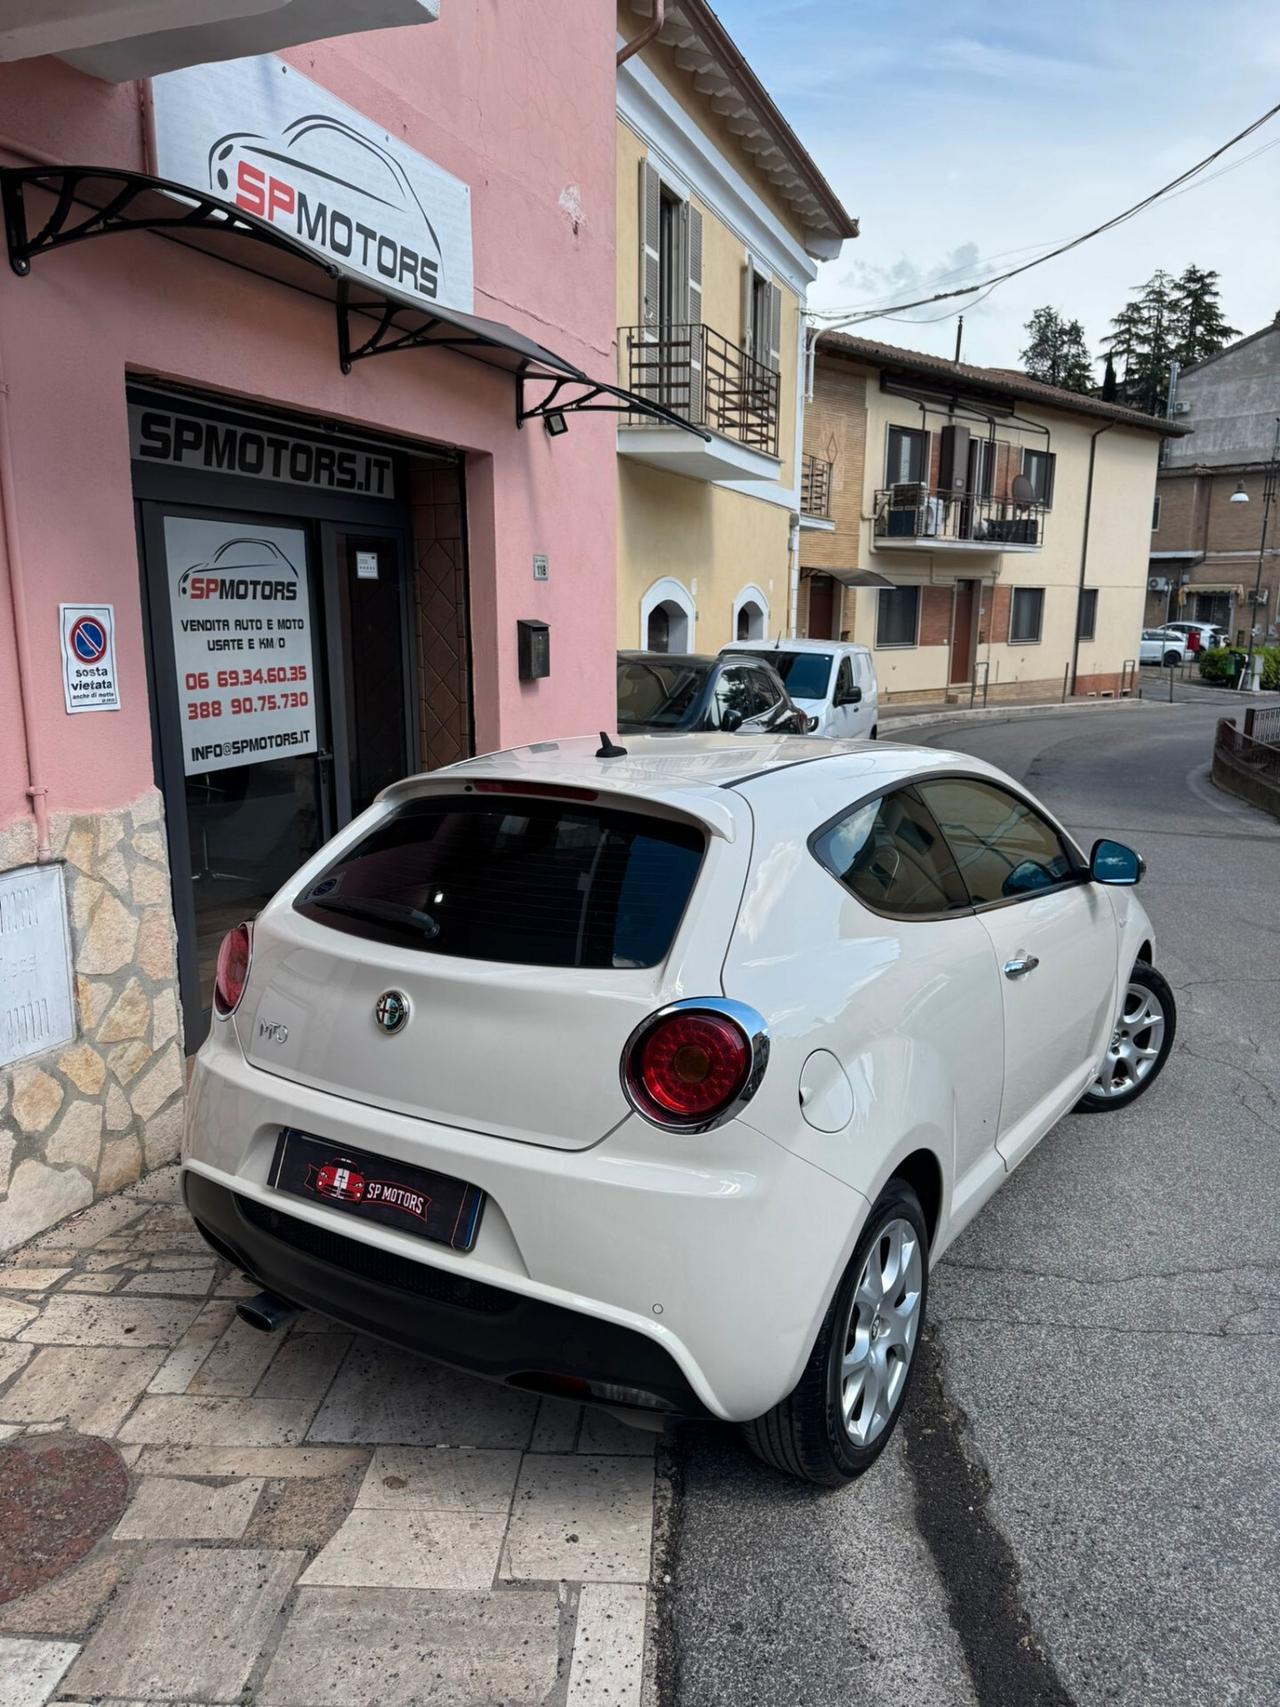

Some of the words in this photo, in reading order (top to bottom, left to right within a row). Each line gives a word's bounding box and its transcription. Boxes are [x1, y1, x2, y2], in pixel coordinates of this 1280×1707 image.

[236, 160, 438, 299] SPMOTORS
[140, 411, 390, 494] SPMOTORS.IT
[190, 577, 297, 601] SPMOTORS
[181, 619, 230, 632] VENDITA
[234, 619, 263, 631] AUTO
[267, 619, 274, 630] E
[277, 618, 304, 630] MOTO
[207, 638, 243, 652] USATE
[248, 639, 255, 650] E
[75, 667, 108, 677] sosta
[185, 672, 210, 690] 06
[217, 665, 307, 688] 69.34.60.35
[71, 680, 112, 691] vietata
[187, 700, 222, 720] 388
[231, 691, 309, 715] 90.75.730
[191, 730, 311, 762] INFO@SPMOTORS.IT
[367, 1182, 381, 1199] SP
[382, 1188, 425, 1215] MOTORS
